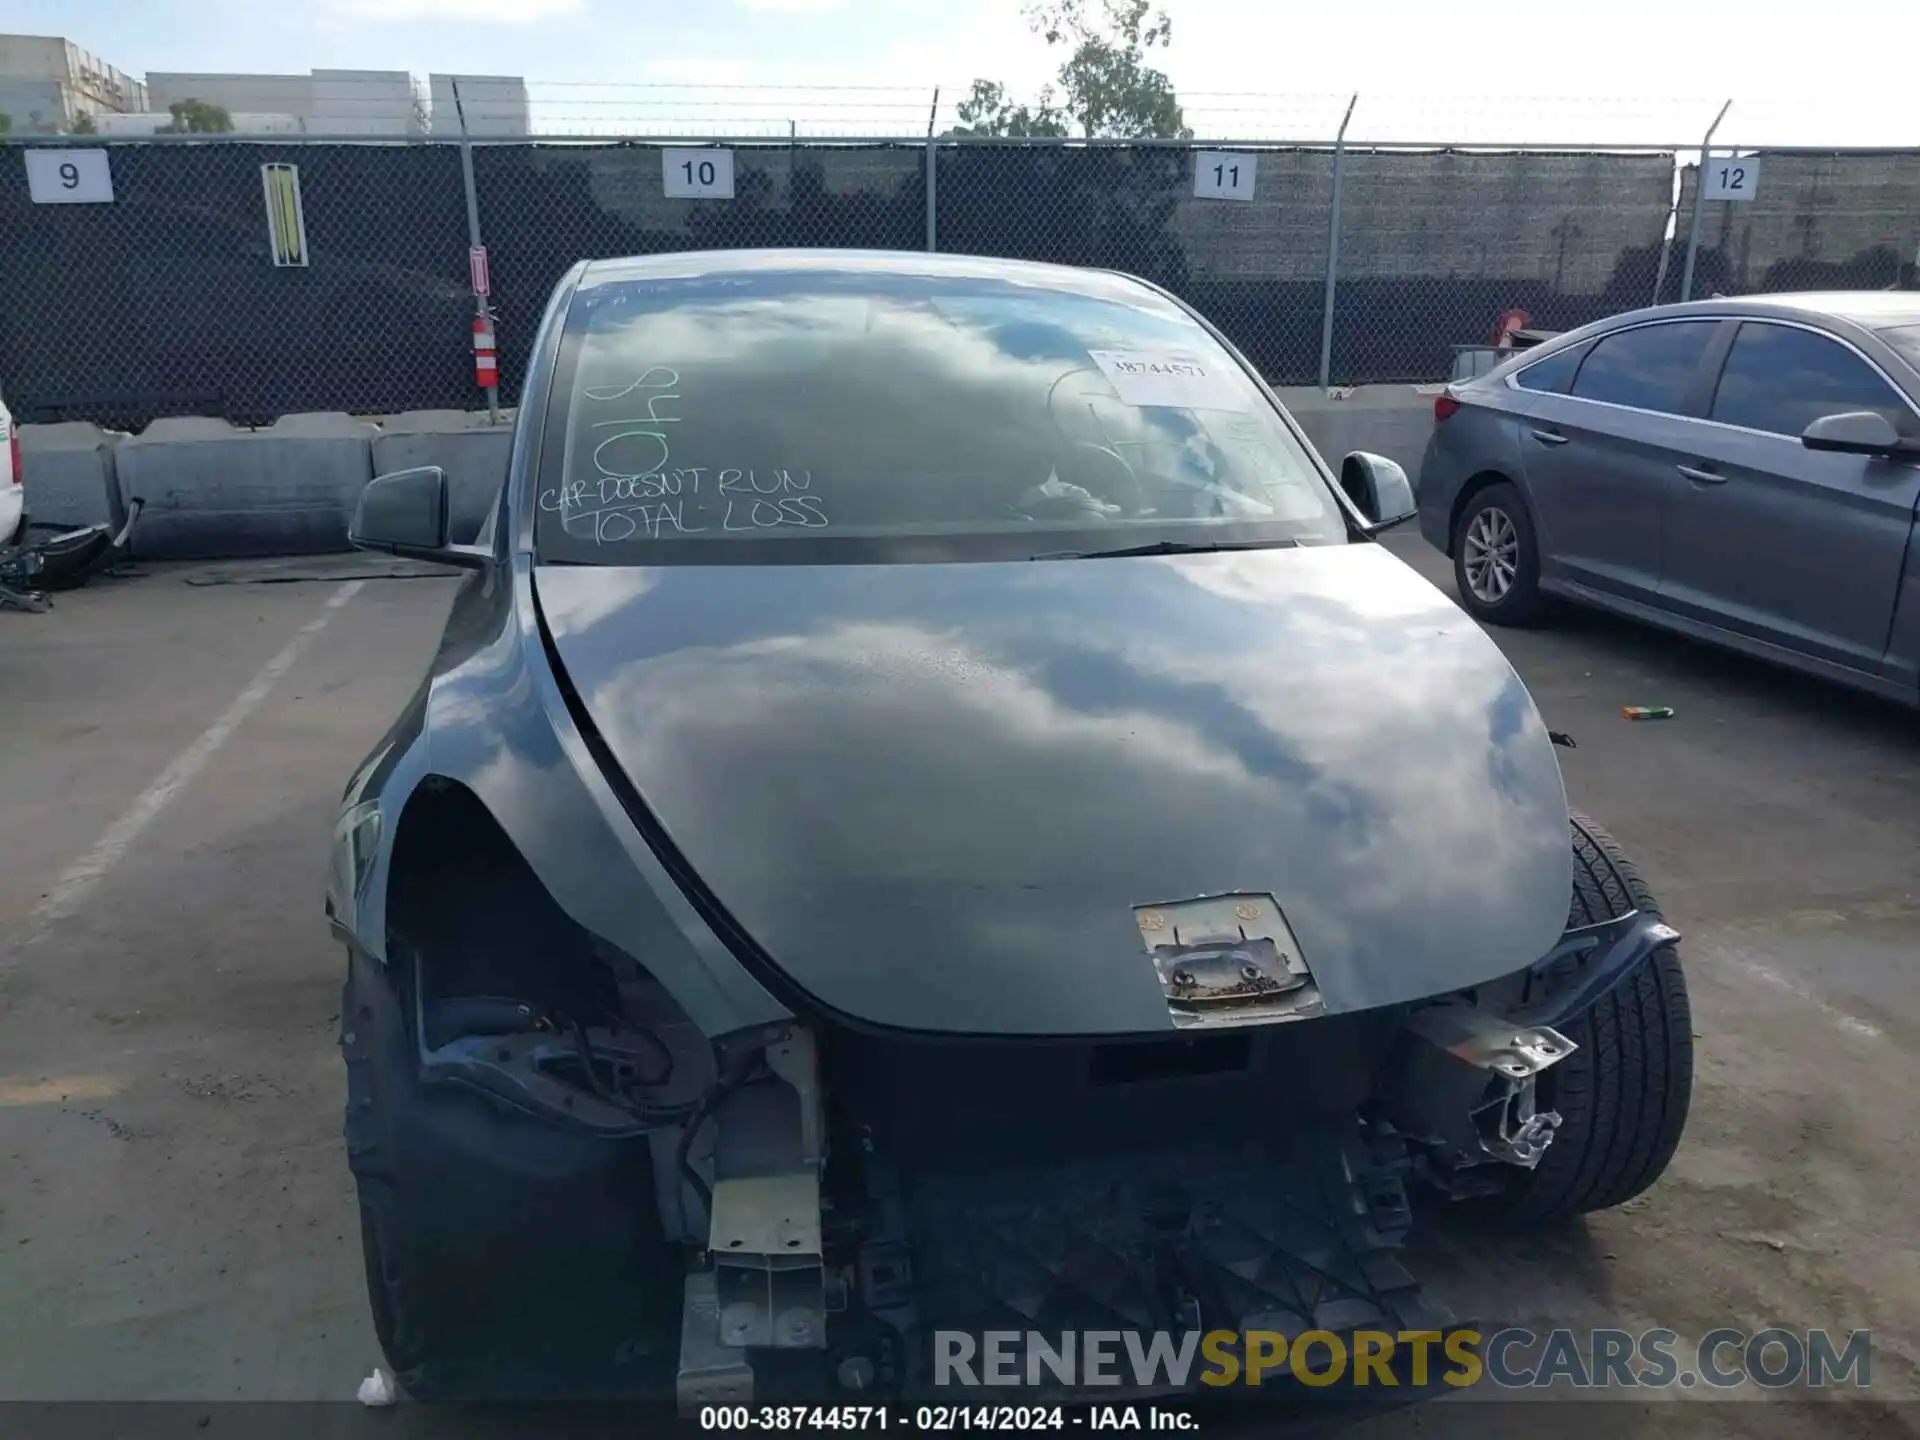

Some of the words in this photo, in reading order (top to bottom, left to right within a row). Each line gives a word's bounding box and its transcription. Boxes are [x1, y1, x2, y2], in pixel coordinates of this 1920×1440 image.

[59, 163, 79, 189] 9
[681, 160, 715, 185] 10
[1213, 164, 1239, 188] 11
[1720, 168, 1745, 189] 12
[1113, 361, 1206, 377] 38744571
[539, 479, 597, 511] CAR
[719, 468, 812, 497] RUN
[723, 495, 829, 531] LOSS
